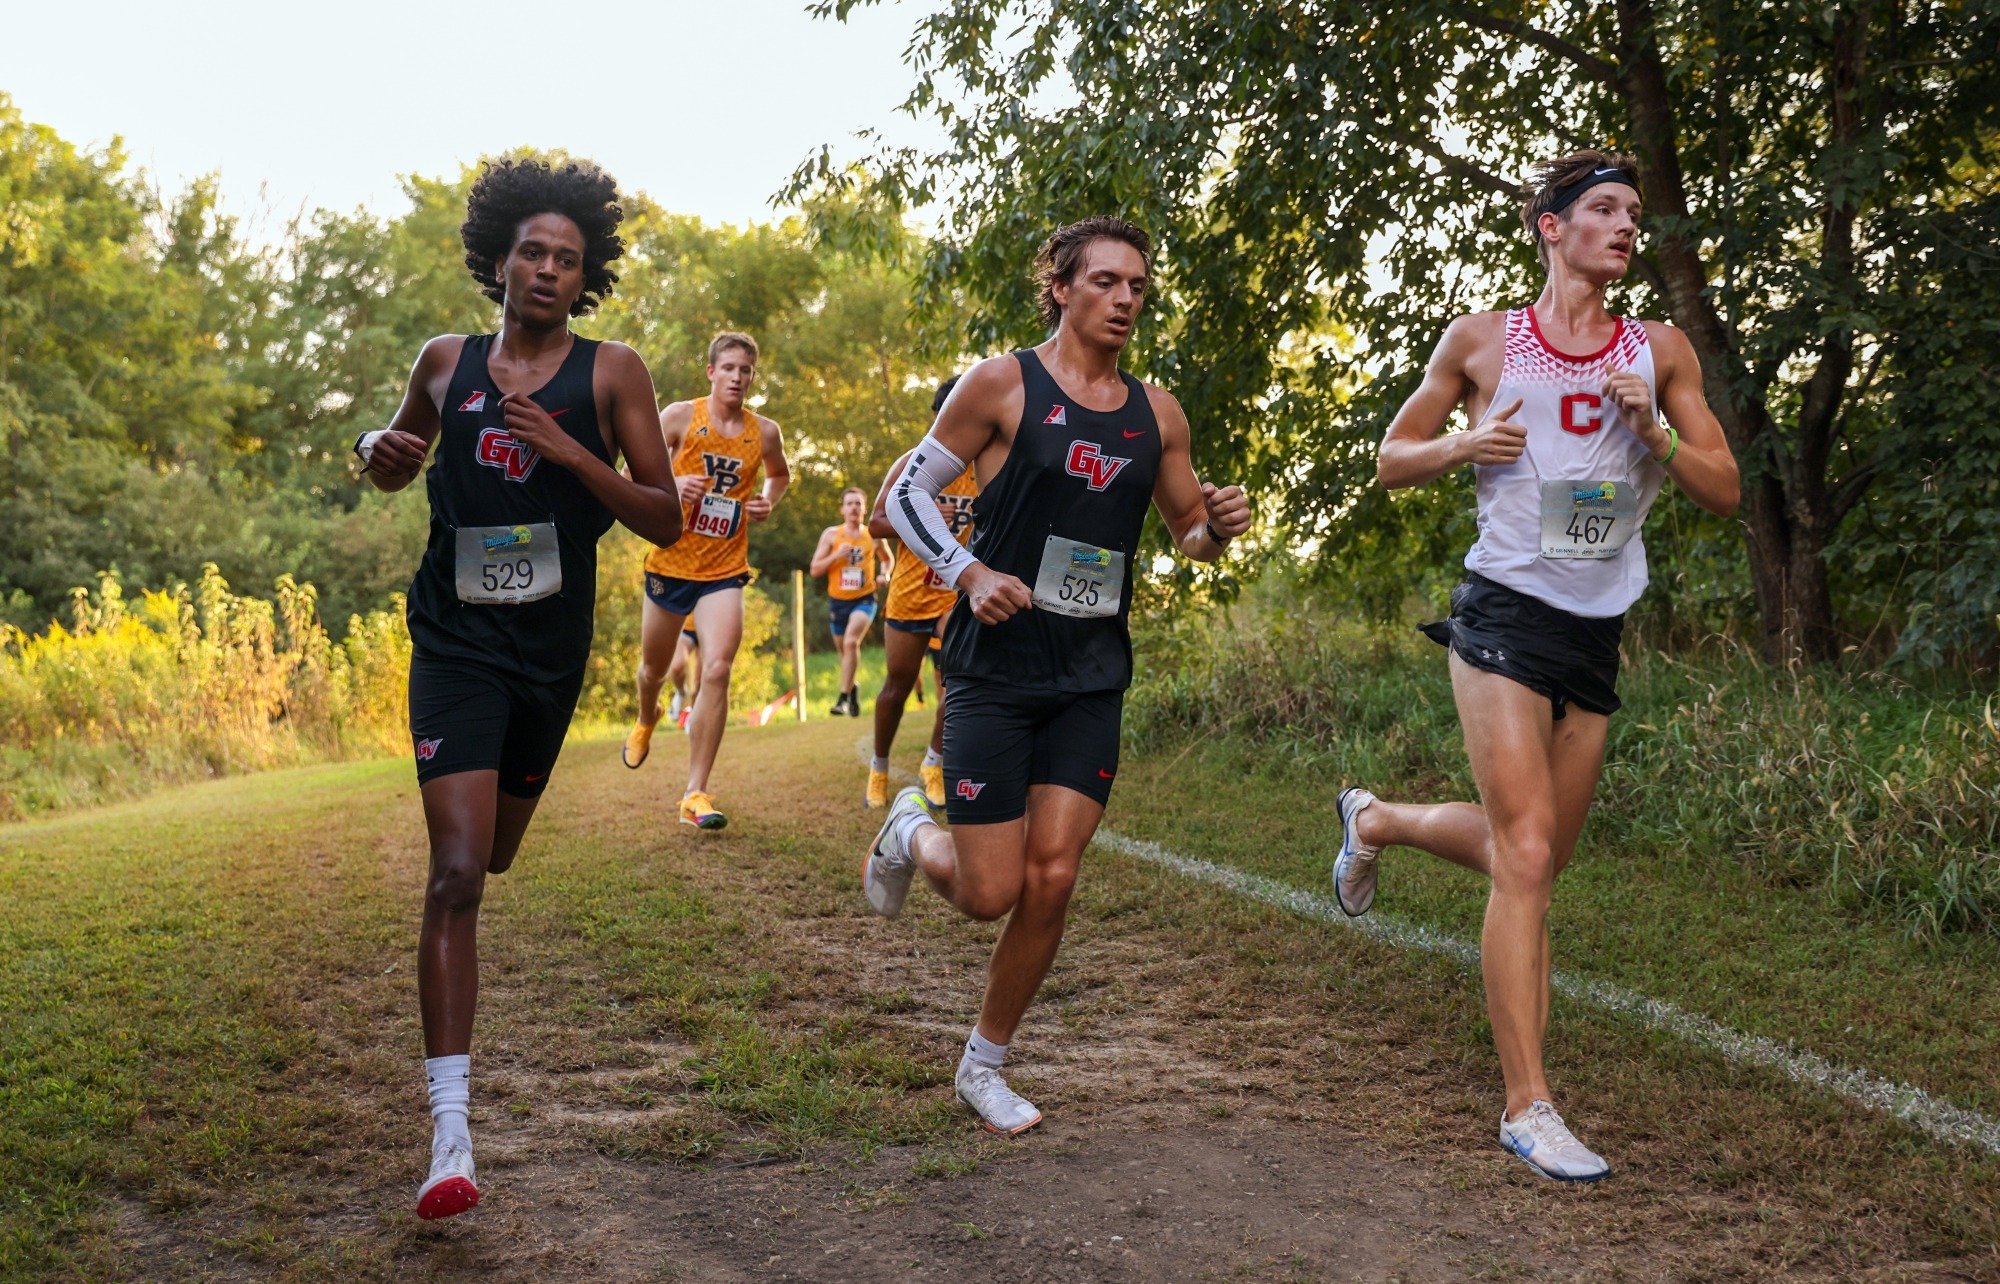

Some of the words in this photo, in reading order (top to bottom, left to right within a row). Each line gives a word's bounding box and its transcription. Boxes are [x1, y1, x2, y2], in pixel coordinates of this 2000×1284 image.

[1560, 391, 1603, 437] C
[476, 427, 541, 483] GV
[1065, 439, 1133, 492] GV
[696, 514, 730, 536] 949
[1565, 512, 1615, 545] 467
[482, 559, 534, 592] 529
[1059, 574, 1103, 606] 525
[956, 779, 987, 800] GV
